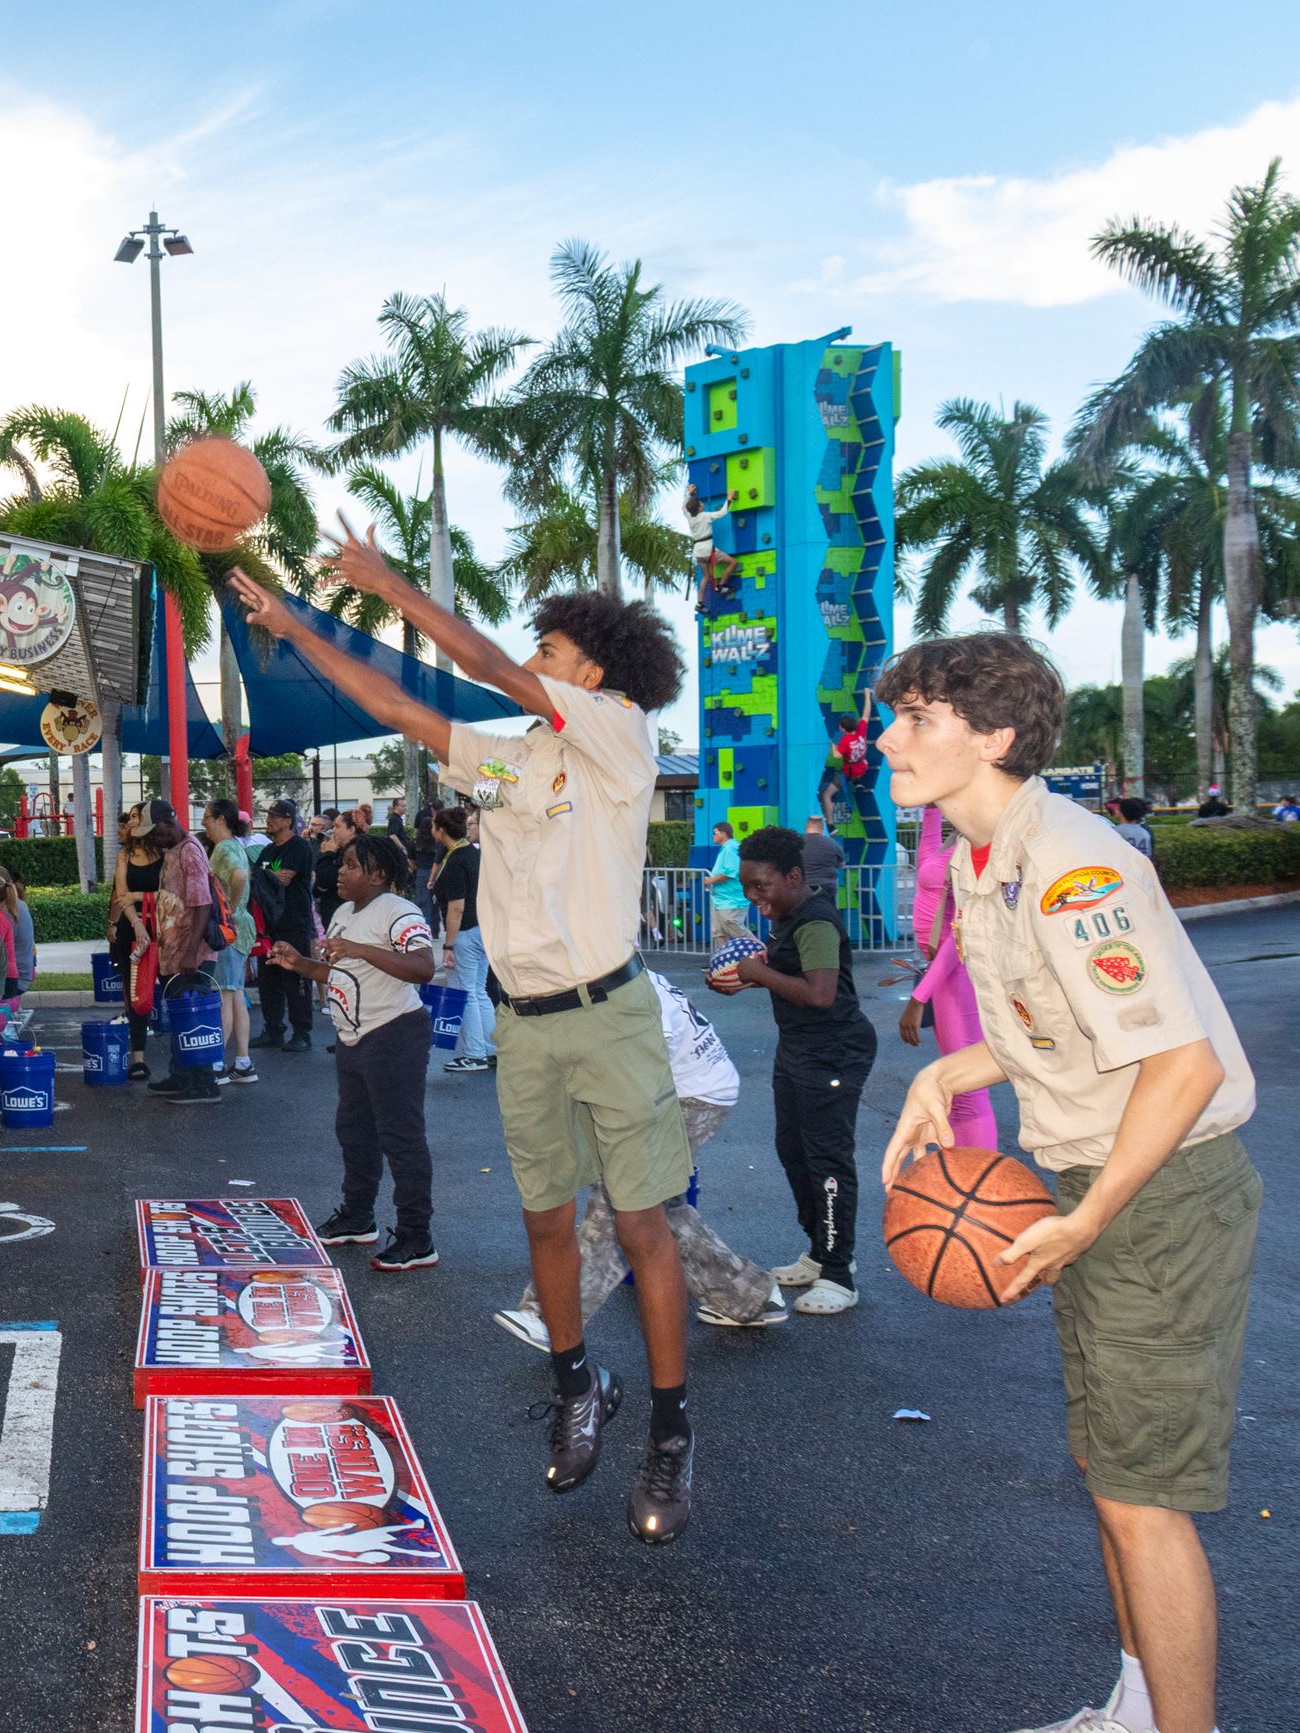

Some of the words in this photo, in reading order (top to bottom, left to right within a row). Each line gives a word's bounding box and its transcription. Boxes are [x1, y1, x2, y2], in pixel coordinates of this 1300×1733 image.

[9, 624, 64, 660] BUSINESS
[73, 732, 99, 753] RACE
[1074, 906, 1131, 941] 406
[183, 1032, 221, 1048] LOWE'S
[5, 1095, 44, 1108] LOWE'S
[823, 1177, 838, 1252] Champion
[153, 1235, 200, 1266] HOOP
[158, 1271, 219, 1317] SHOTS
[154, 1319, 220, 1364] HOOP
[166, 1401, 246, 1480] SHOTS
[280, 1425, 331, 1448] IN
[289, 1451, 338, 1500] ONE
[325, 1424, 388, 1501] WINS!!
[166, 1484, 256, 1565] HOOP
